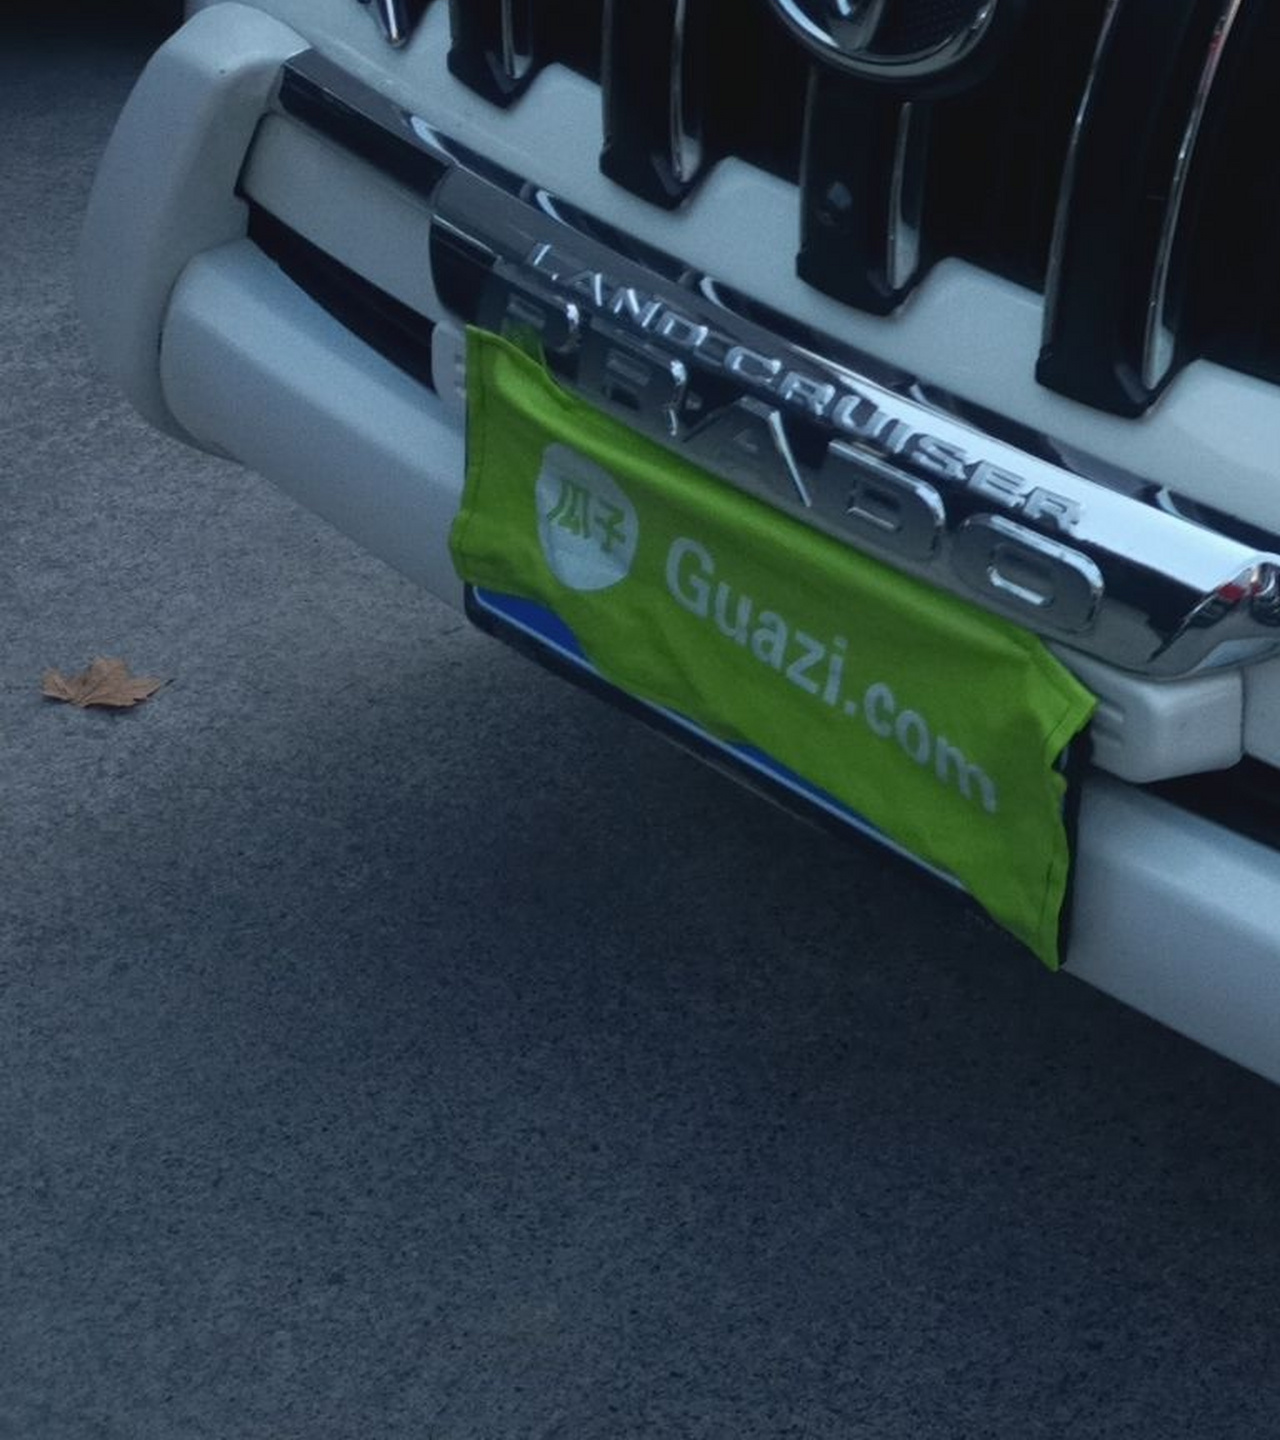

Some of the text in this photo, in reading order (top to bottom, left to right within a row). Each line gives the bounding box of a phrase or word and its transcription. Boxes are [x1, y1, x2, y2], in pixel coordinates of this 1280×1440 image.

[527, 242, 1086, 538] LAND CRUISER
[665, 536, 998, 815] Guazi.com
